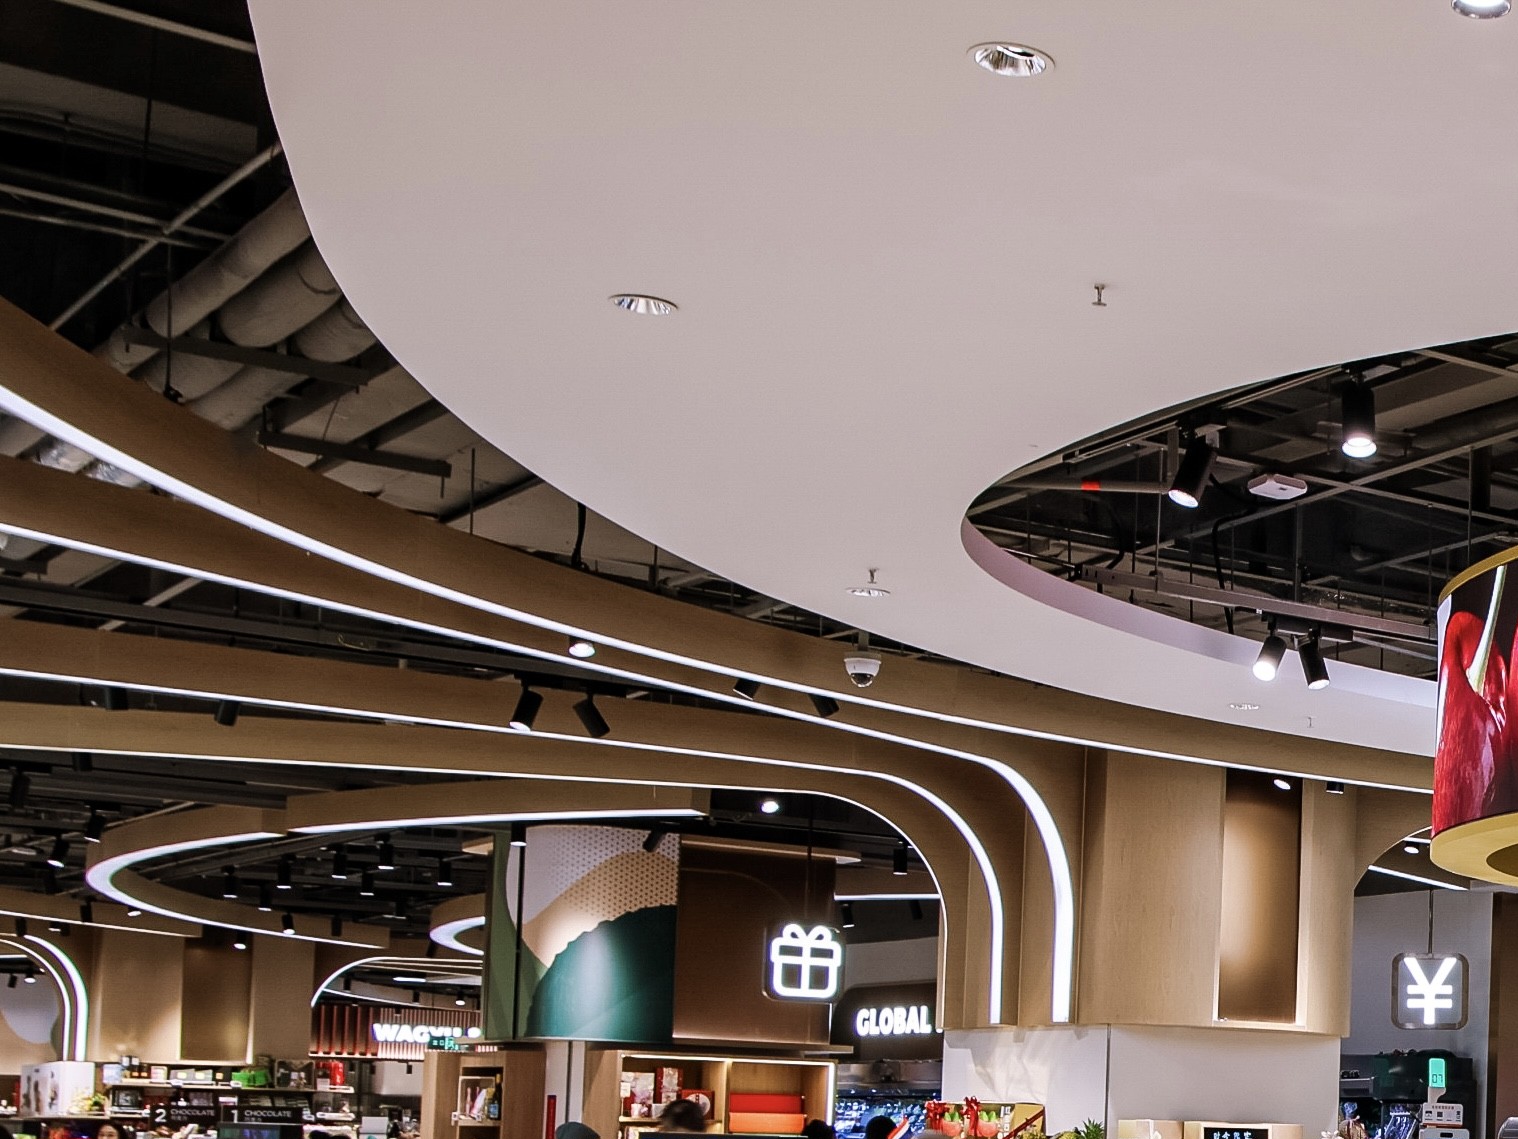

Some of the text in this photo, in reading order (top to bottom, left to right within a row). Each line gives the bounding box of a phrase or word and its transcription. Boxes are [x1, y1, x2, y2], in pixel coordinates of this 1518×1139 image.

[856, 1005, 932, 1037] GLOBAL
[154, 1109, 167, 1123] 2
[170, 1109, 215, 1117] CHOCOLATE
[231, 1110, 239, 1123] 1
[244, 1110, 292, 1118] CHOCOLATE
